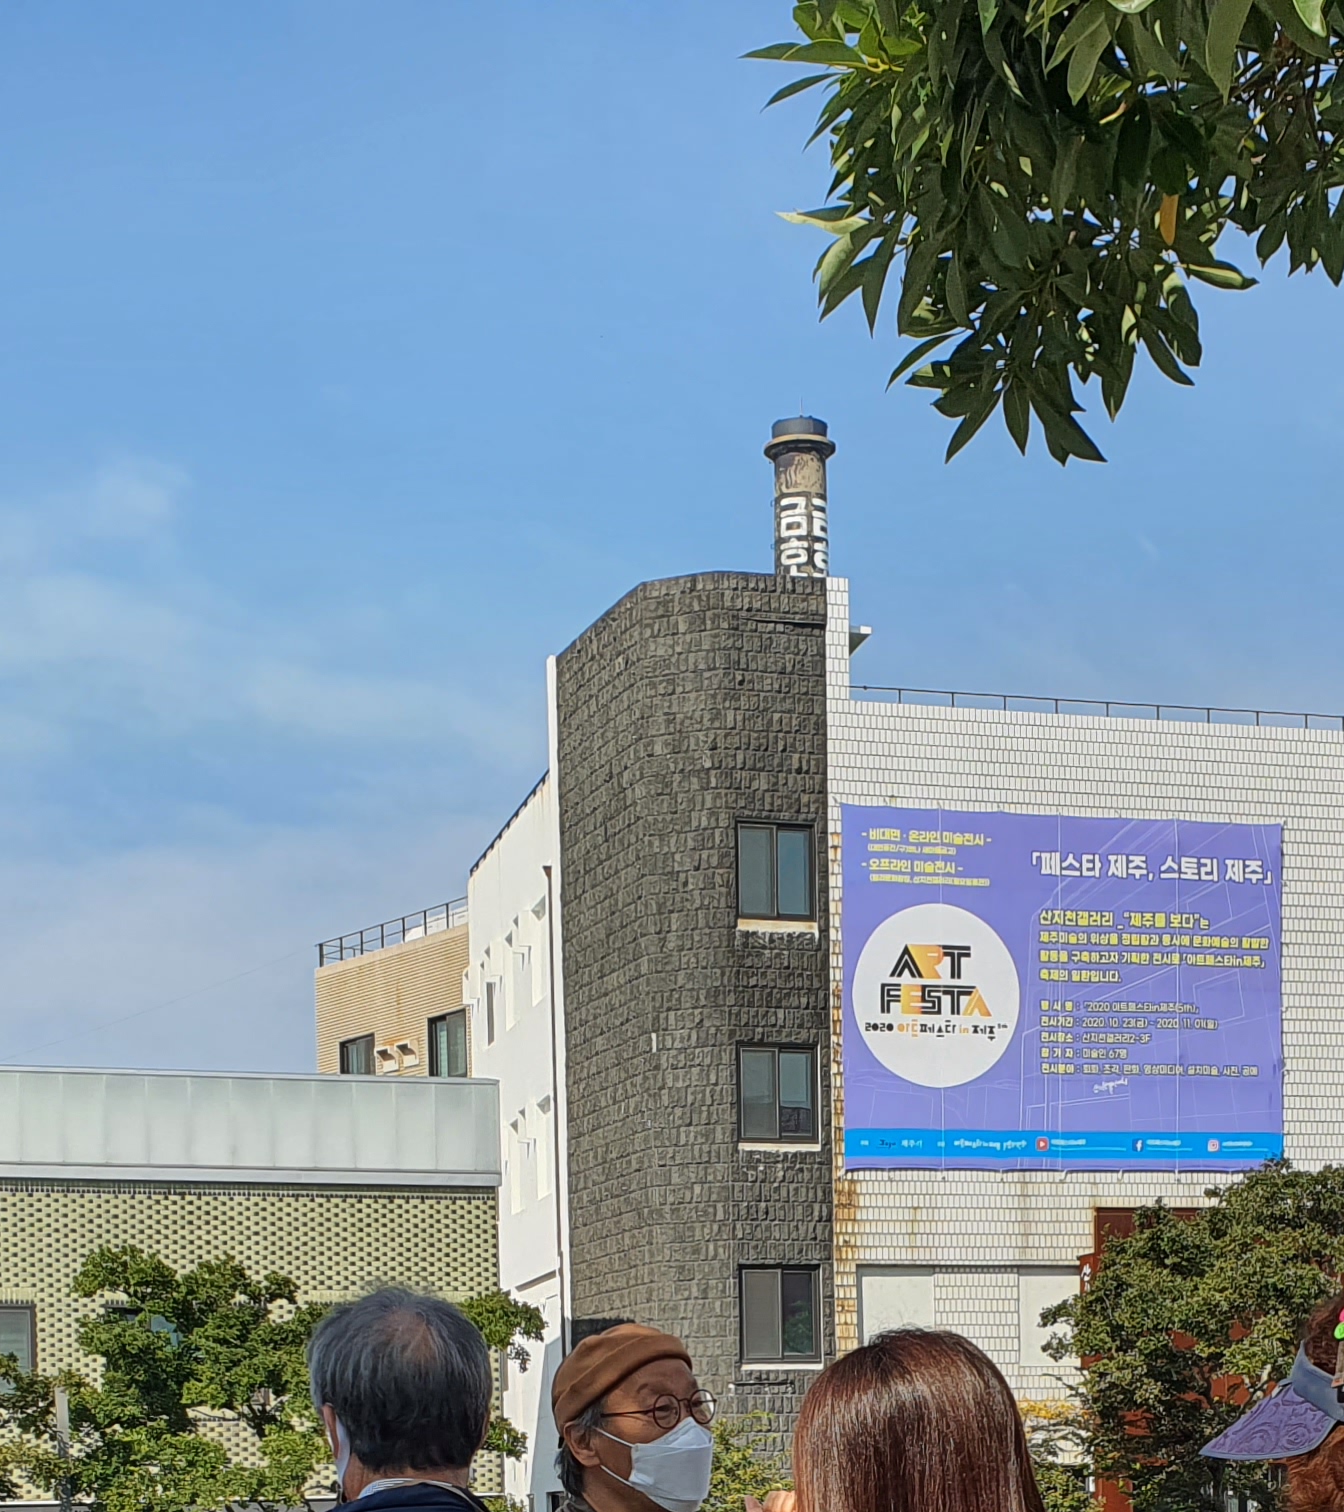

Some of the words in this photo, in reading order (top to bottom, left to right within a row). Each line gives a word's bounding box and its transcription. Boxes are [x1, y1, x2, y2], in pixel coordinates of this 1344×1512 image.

[869, 828, 901, 841] 비대면
[909, 830, 941, 843] 온라인
[942, 832, 984, 846] 미술전시
[869, 858, 912, 872] 오프라인
[914, 860, 955, 874] 미술전시
[1107, 854, 1154, 882] 제주,
[1160, 856, 1219, 882] 스토리
[1224, 858, 1273, 884] 제주」
[1040, 910, 1113, 926] 산지천갤러리
[1040, 931, 1087, 944] 제주미술의
[889, 943, 972, 980] ART
[880, 983, 992, 1017] FESTA
[865, 1022, 894, 1033] 2020
